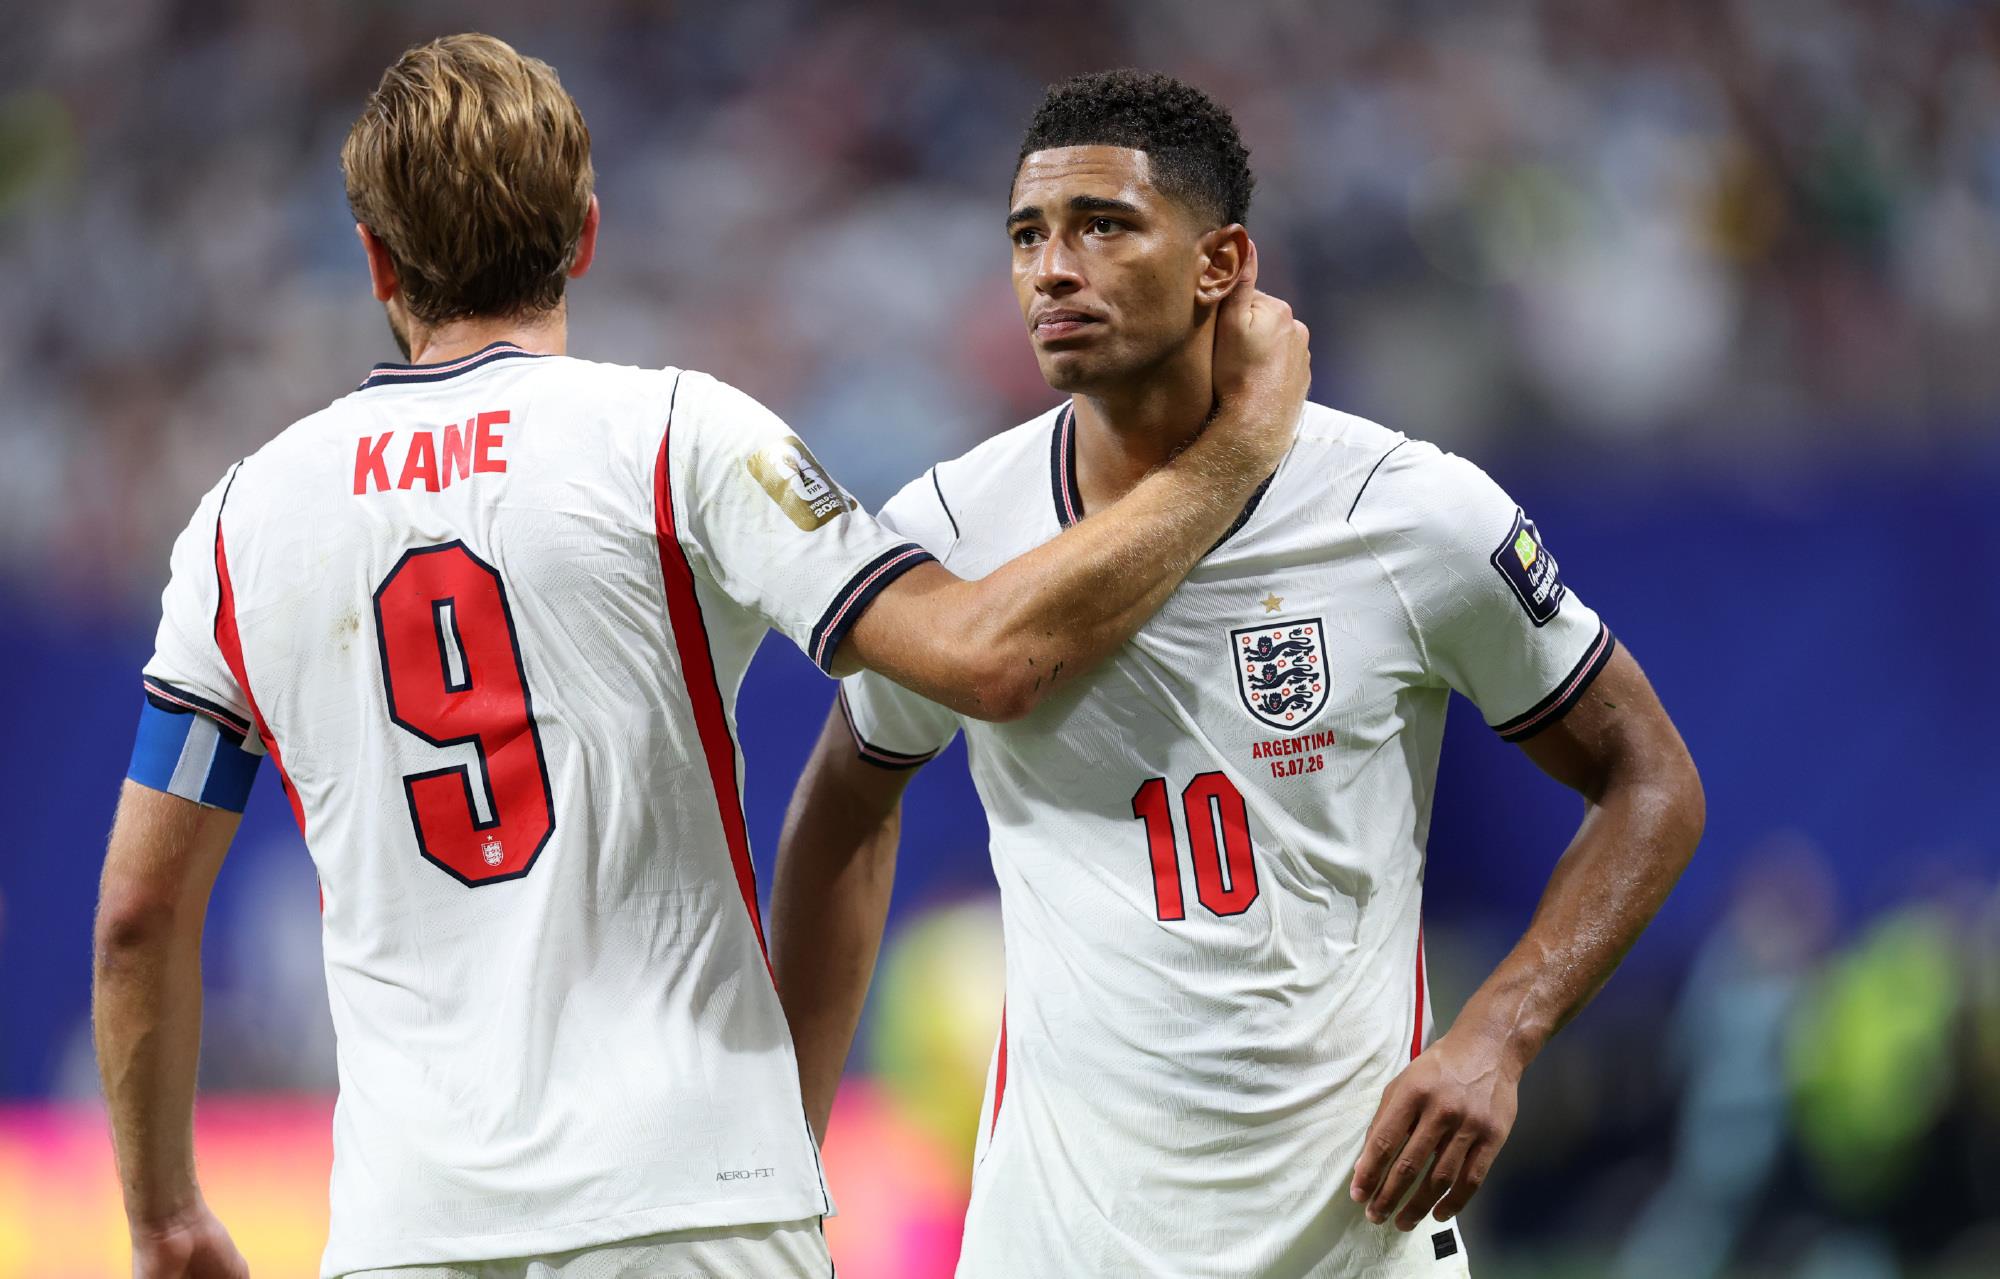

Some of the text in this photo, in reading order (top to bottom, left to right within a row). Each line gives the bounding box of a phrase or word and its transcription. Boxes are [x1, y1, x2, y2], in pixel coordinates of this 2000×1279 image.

[353, 410, 510, 495] KANE
[807, 484, 822, 494] FIFA
[809, 496, 830, 510] WORLD
[373, 538, 556, 889] 9
[1252, 730, 1335, 759] ARGENTINA
[1270, 754, 1324, 779] 15.07.26
[1131, 770, 1260, 921] 10
[716, 1167, 775, 1181] AERO-FIT
